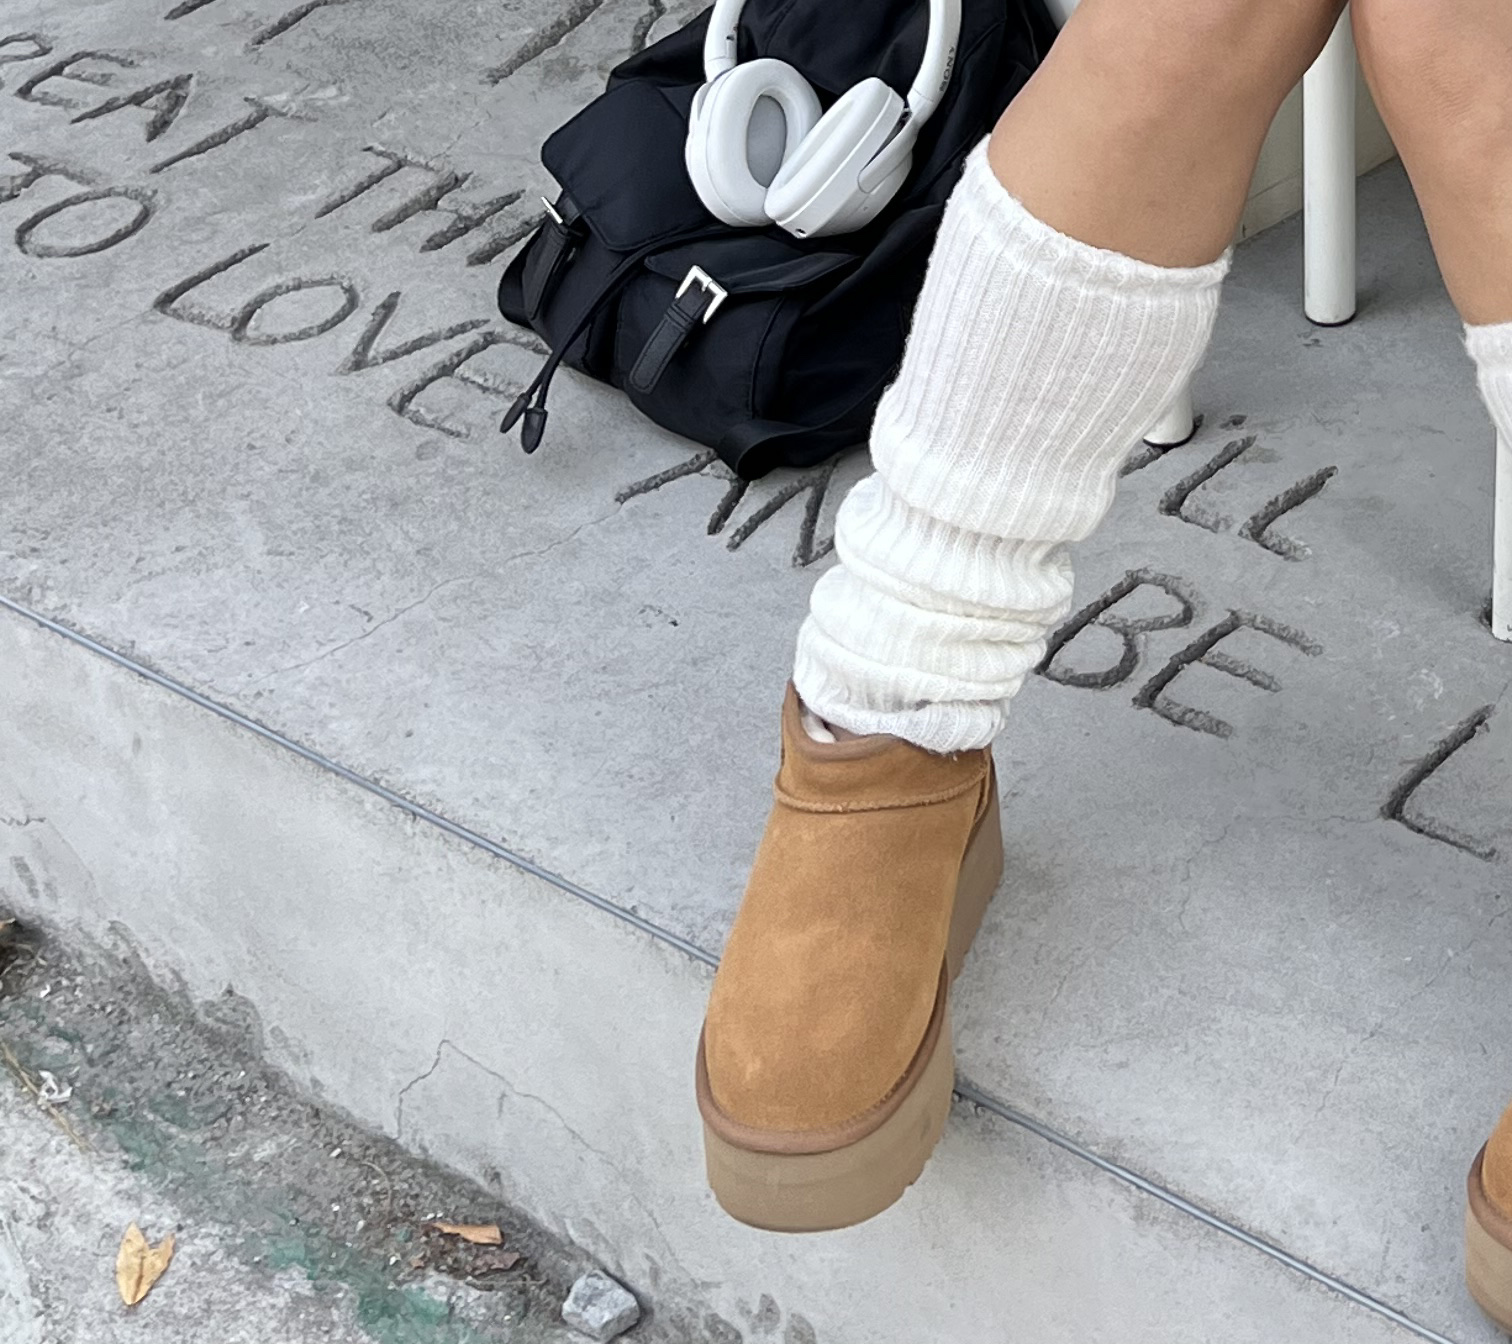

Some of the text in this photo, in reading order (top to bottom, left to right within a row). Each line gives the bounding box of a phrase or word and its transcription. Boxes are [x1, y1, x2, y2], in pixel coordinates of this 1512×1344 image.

[0, 151, 158, 258] TO
[152, 242, 556, 440] LOVE
[1035, 568, 1323, 740] BE
